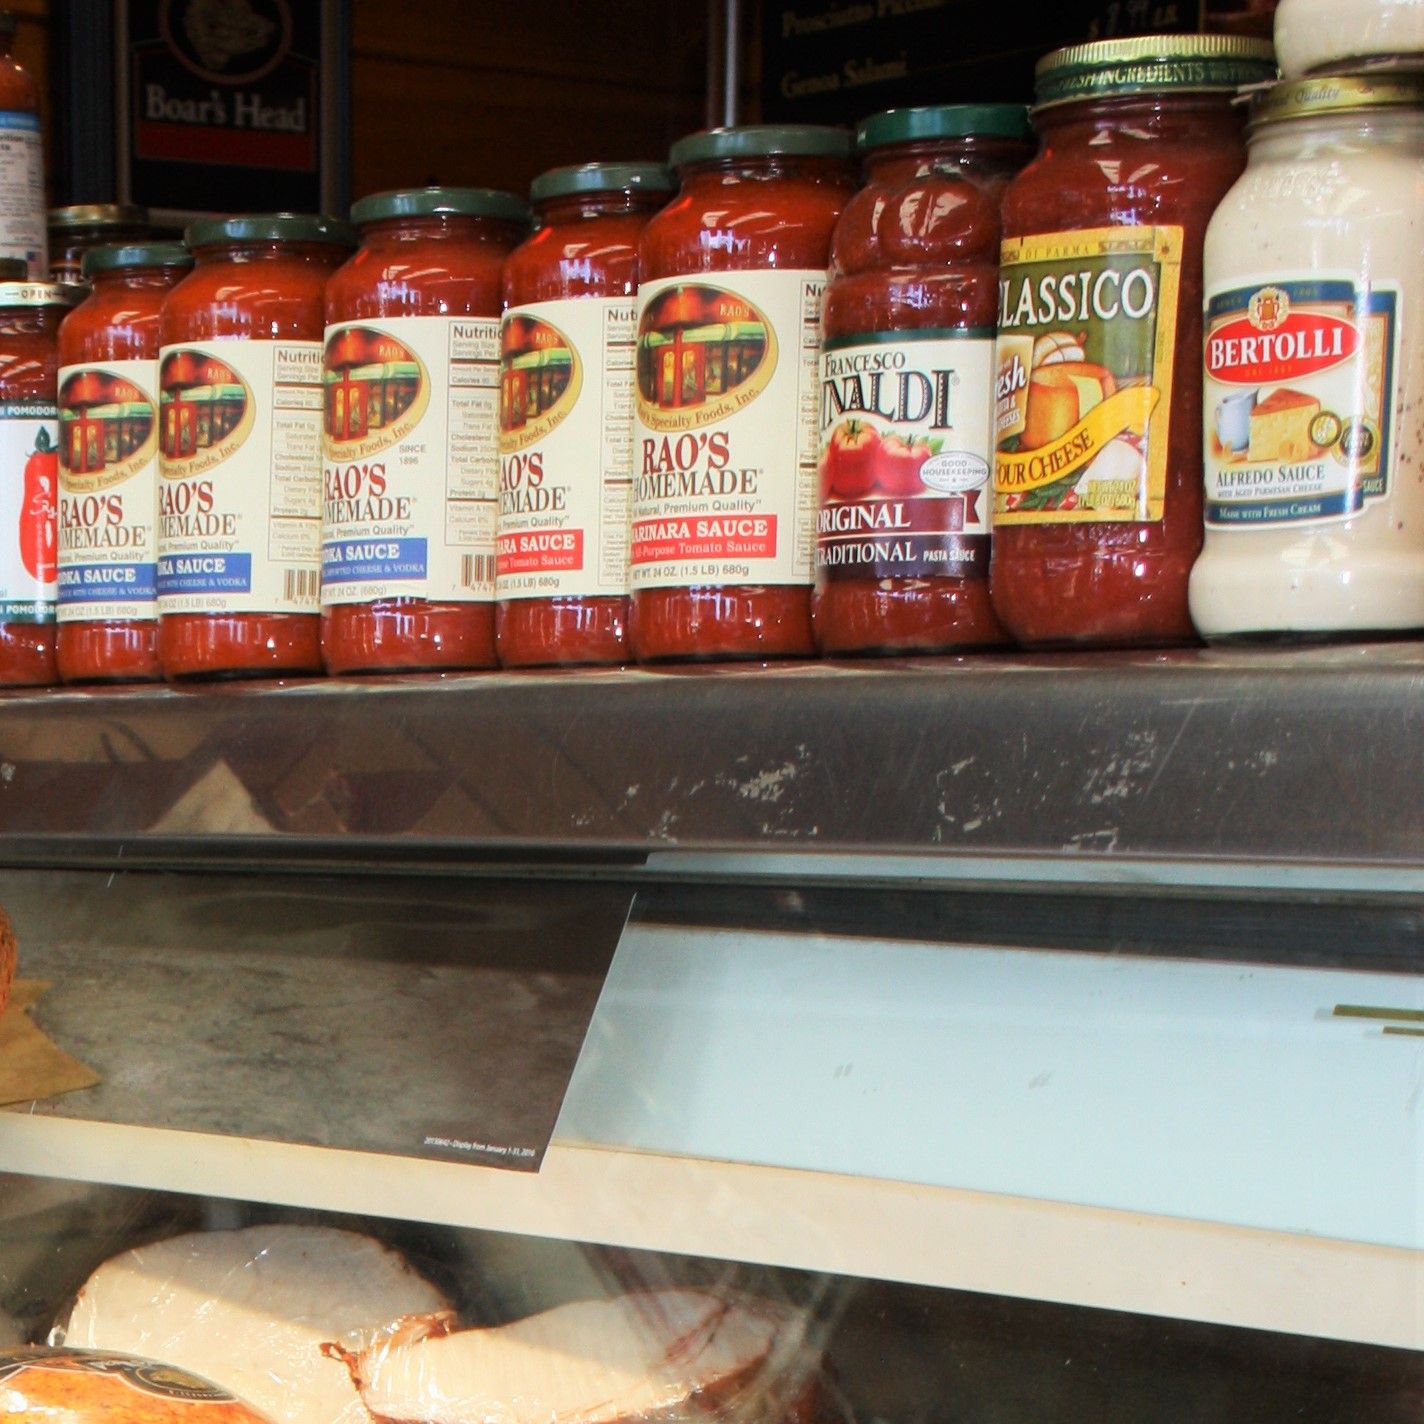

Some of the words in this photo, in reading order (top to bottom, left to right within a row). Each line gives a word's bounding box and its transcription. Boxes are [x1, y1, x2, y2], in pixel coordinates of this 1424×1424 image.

[146, 83, 227, 124] Boar's
[234, 92, 306, 132] Head
[1210, 327, 1344, 370] BERTOLLI
[826, 351, 906, 377] FRANCESCO
[642, 431, 730, 475] RAO'S
[1029, 428, 1095, 481] CHEESE
[1216, 471, 1274, 489] ALFREDO
[1278, 464, 1325, 483] SAUCE
[61, 495, 124, 529] RAO'S
[664, 501, 709, 515] Premium
[697, 519, 768, 538] SAUCE
[346, 542, 400, 561] SAUCE
[520, 534, 575, 552] SAUCE
[679, 541, 723, 556] Tomato
[177, 557, 226, 574] SAUCE
[923, 551, 948, 562] PASTA
[84, 568, 136, 583] SAUCE
